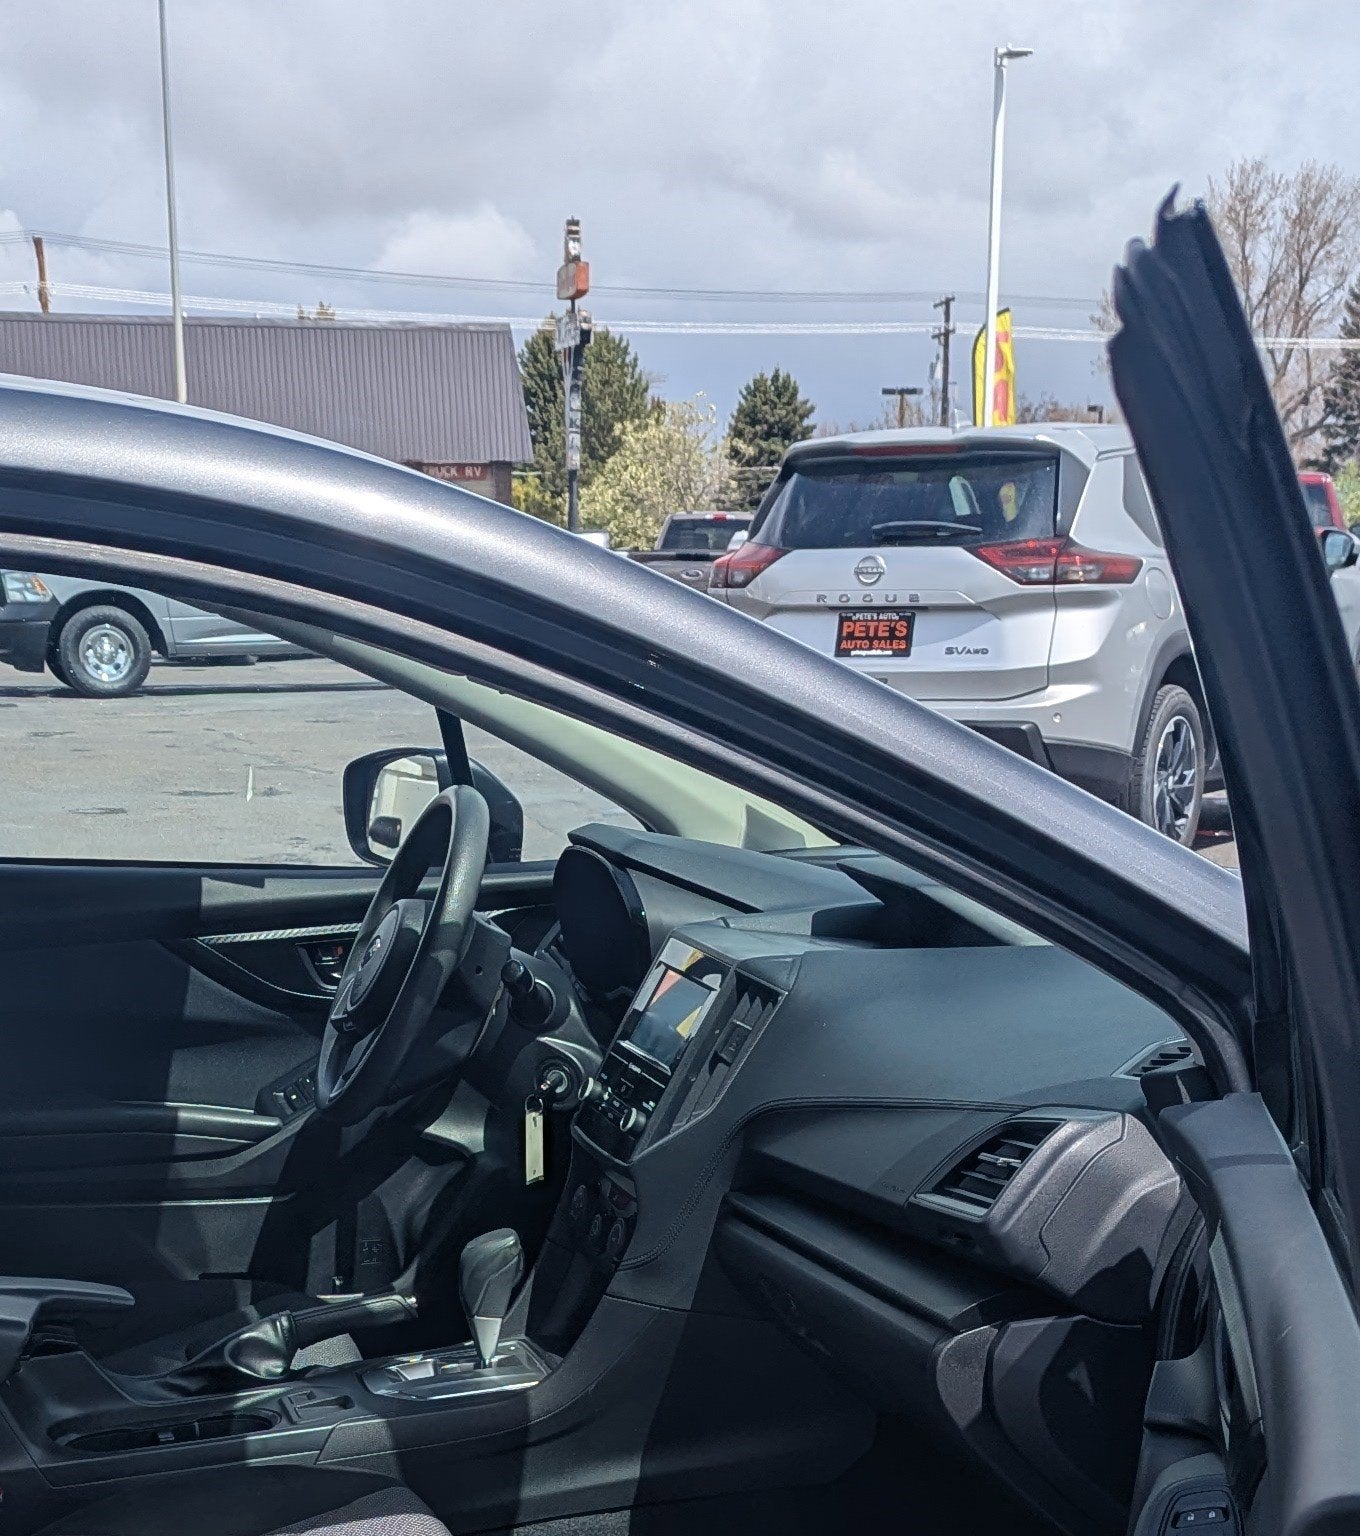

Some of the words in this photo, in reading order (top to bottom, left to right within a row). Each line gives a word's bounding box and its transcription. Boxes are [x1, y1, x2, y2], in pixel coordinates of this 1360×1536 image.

[816, 593, 920, 603] ROGUE
[842, 621, 909, 637] PETE'S
[840, 640, 870, 649] AUTO
[872, 640, 907, 649] SALES
